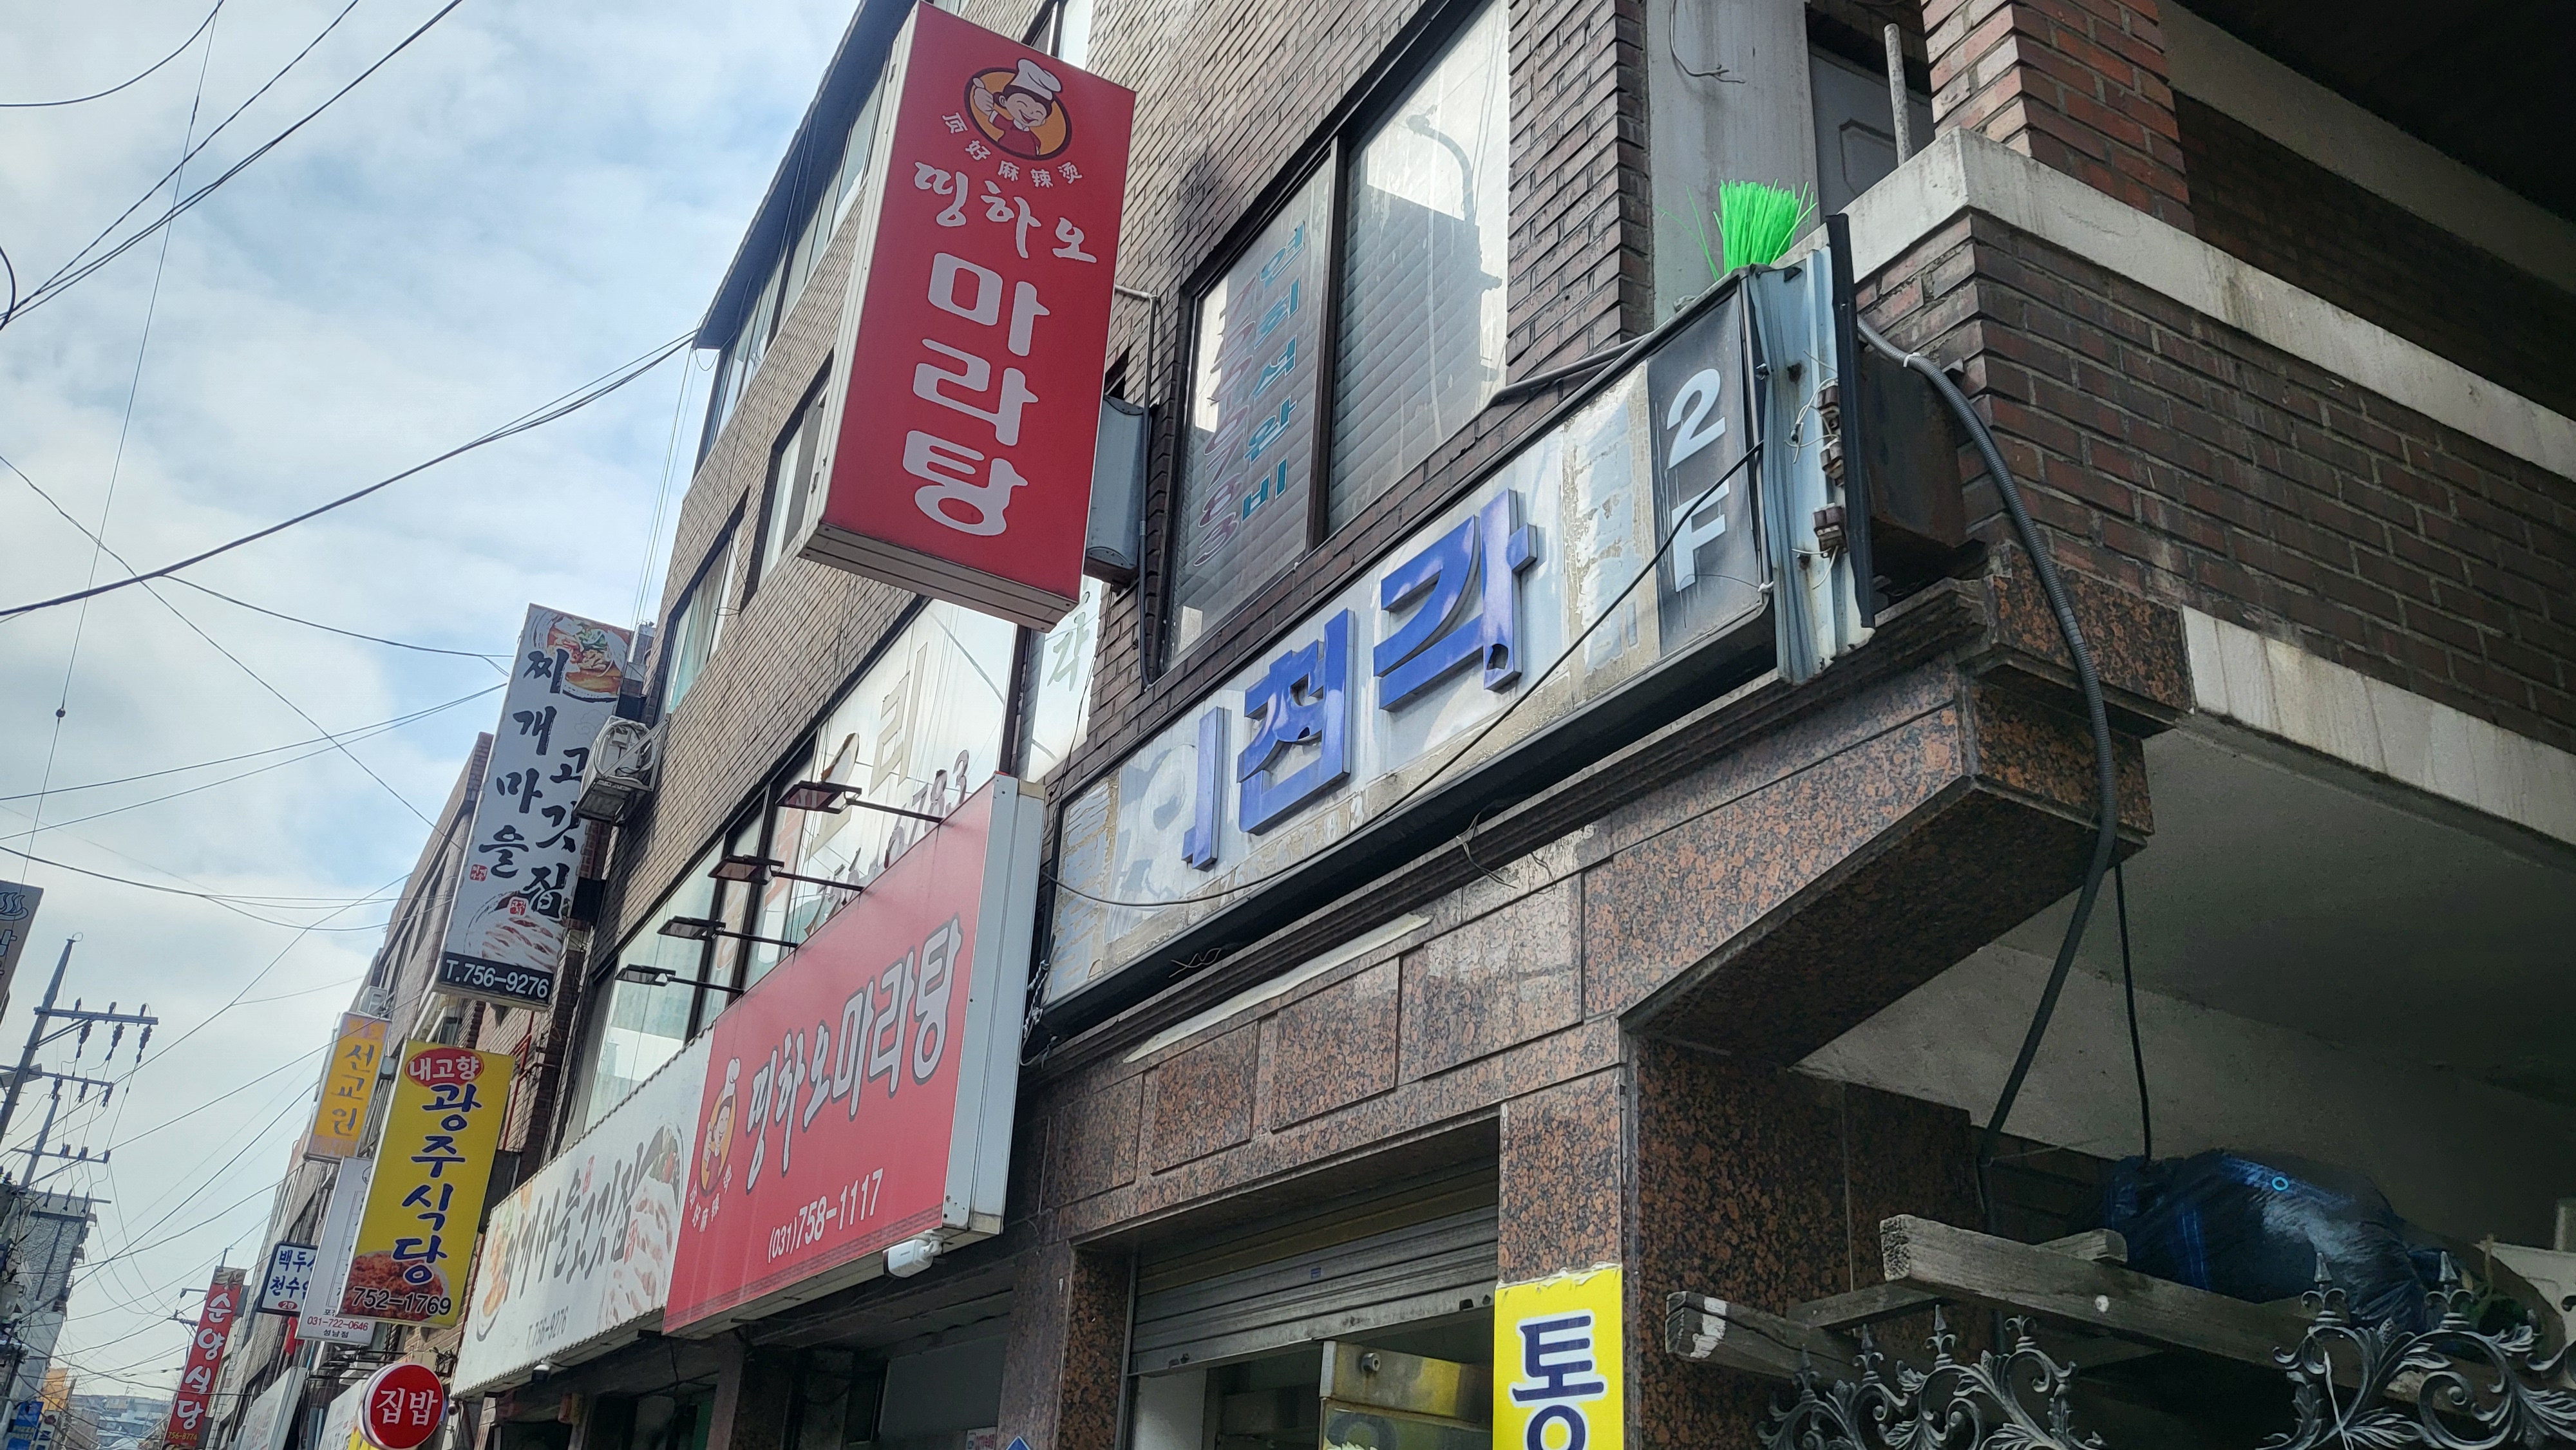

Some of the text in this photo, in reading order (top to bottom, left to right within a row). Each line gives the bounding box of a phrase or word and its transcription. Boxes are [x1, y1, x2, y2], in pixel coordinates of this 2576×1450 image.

[914, 162, 1097, 263] 띵하오
[902, 252, 1050, 536] 마라탕
[478, 648, 569, 878] 찌개마을
[518, 746, 587, 922] 고깃집
[444, 959, 549, 1000] T.756-9276
[409, 1055, 480, 1083] 내고향
[392, 1084, 482, 1286] 광주식당
[768, 1168, 884, 1264] (031)758-1117
[307, 1316, 368, 1332] 031-722-0646
[323, 1329, 349, 1339] 성남점
[352, 1286, 452, 1317] 752-1769
[177, 1292, 232, 1430] 순양식당
[376, 1388, 439, 1426] 집밥
[1512, 1315, 1604, 1450] 통
